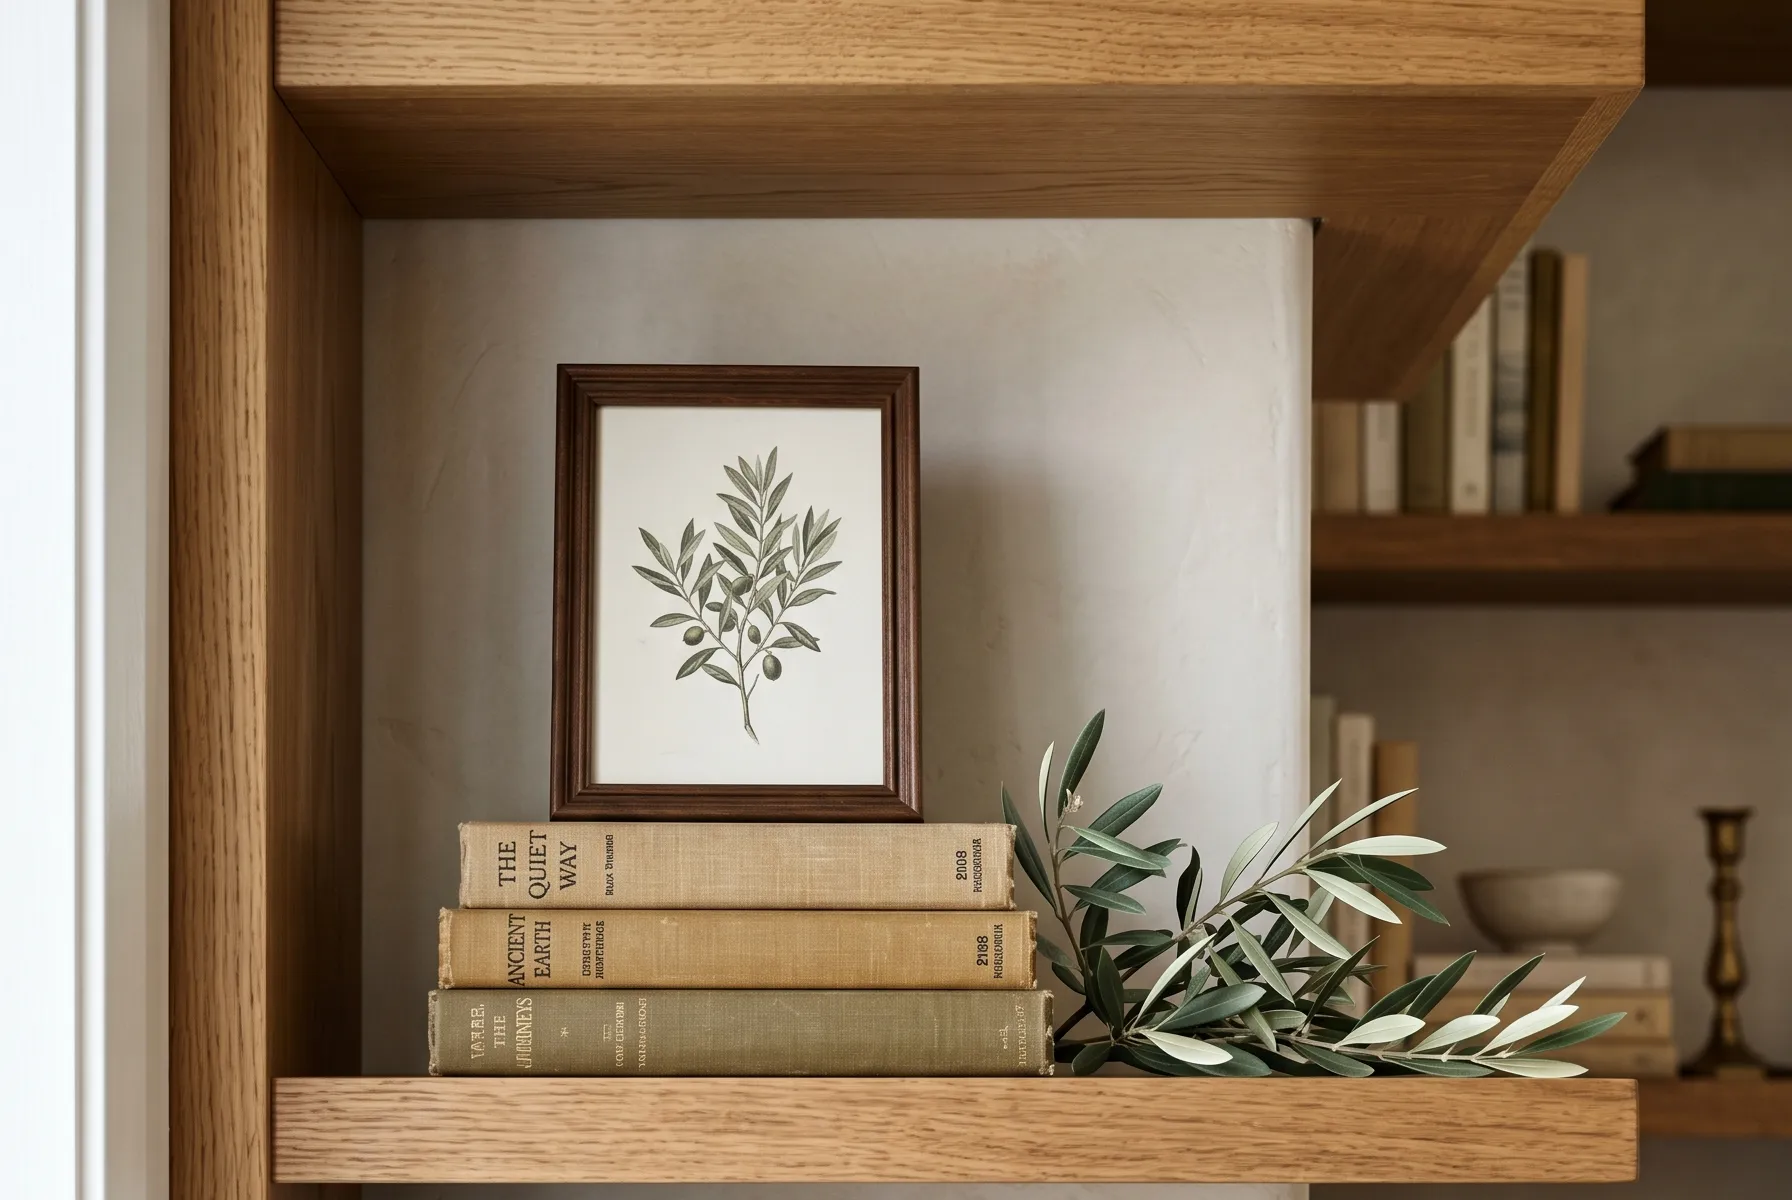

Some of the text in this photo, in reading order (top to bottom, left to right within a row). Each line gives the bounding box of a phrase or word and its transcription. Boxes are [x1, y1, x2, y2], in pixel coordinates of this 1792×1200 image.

[498, 841, 517, 888] THE
[528, 829, 551, 900] QUIET
[559, 840, 577, 891] WAY
[507, 913, 526, 987] ANCIENT
[534, 920, 551, 979] EARTH
[493, 1015, 506, 1049] THE
